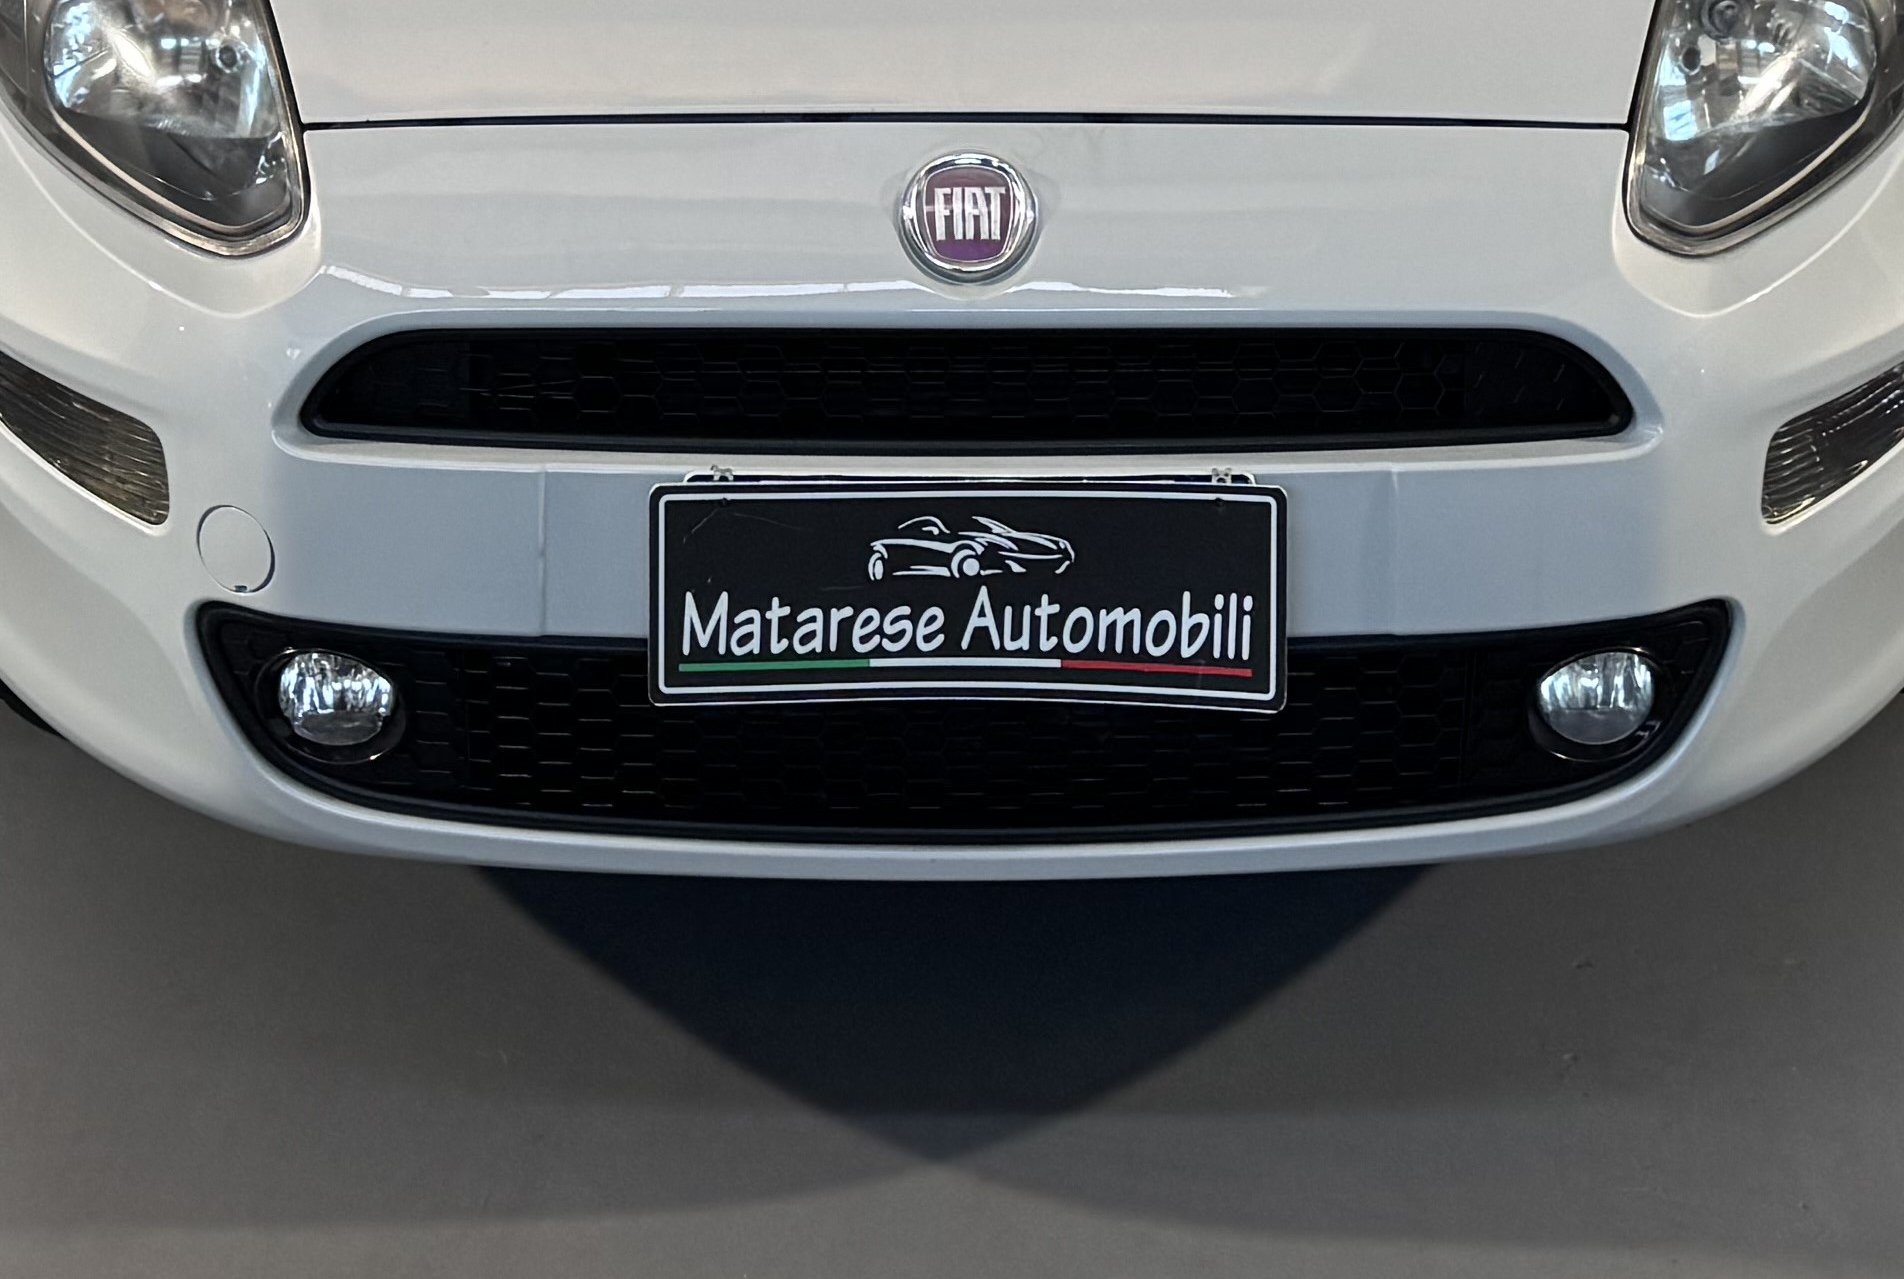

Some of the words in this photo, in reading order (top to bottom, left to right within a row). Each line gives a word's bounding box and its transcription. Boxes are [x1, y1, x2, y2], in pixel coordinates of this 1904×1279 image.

[933, 185, 1007, 242] FIAT
[681, 590, 946, 657] Matarese
[959, 584, 1255, 662] Automobili
